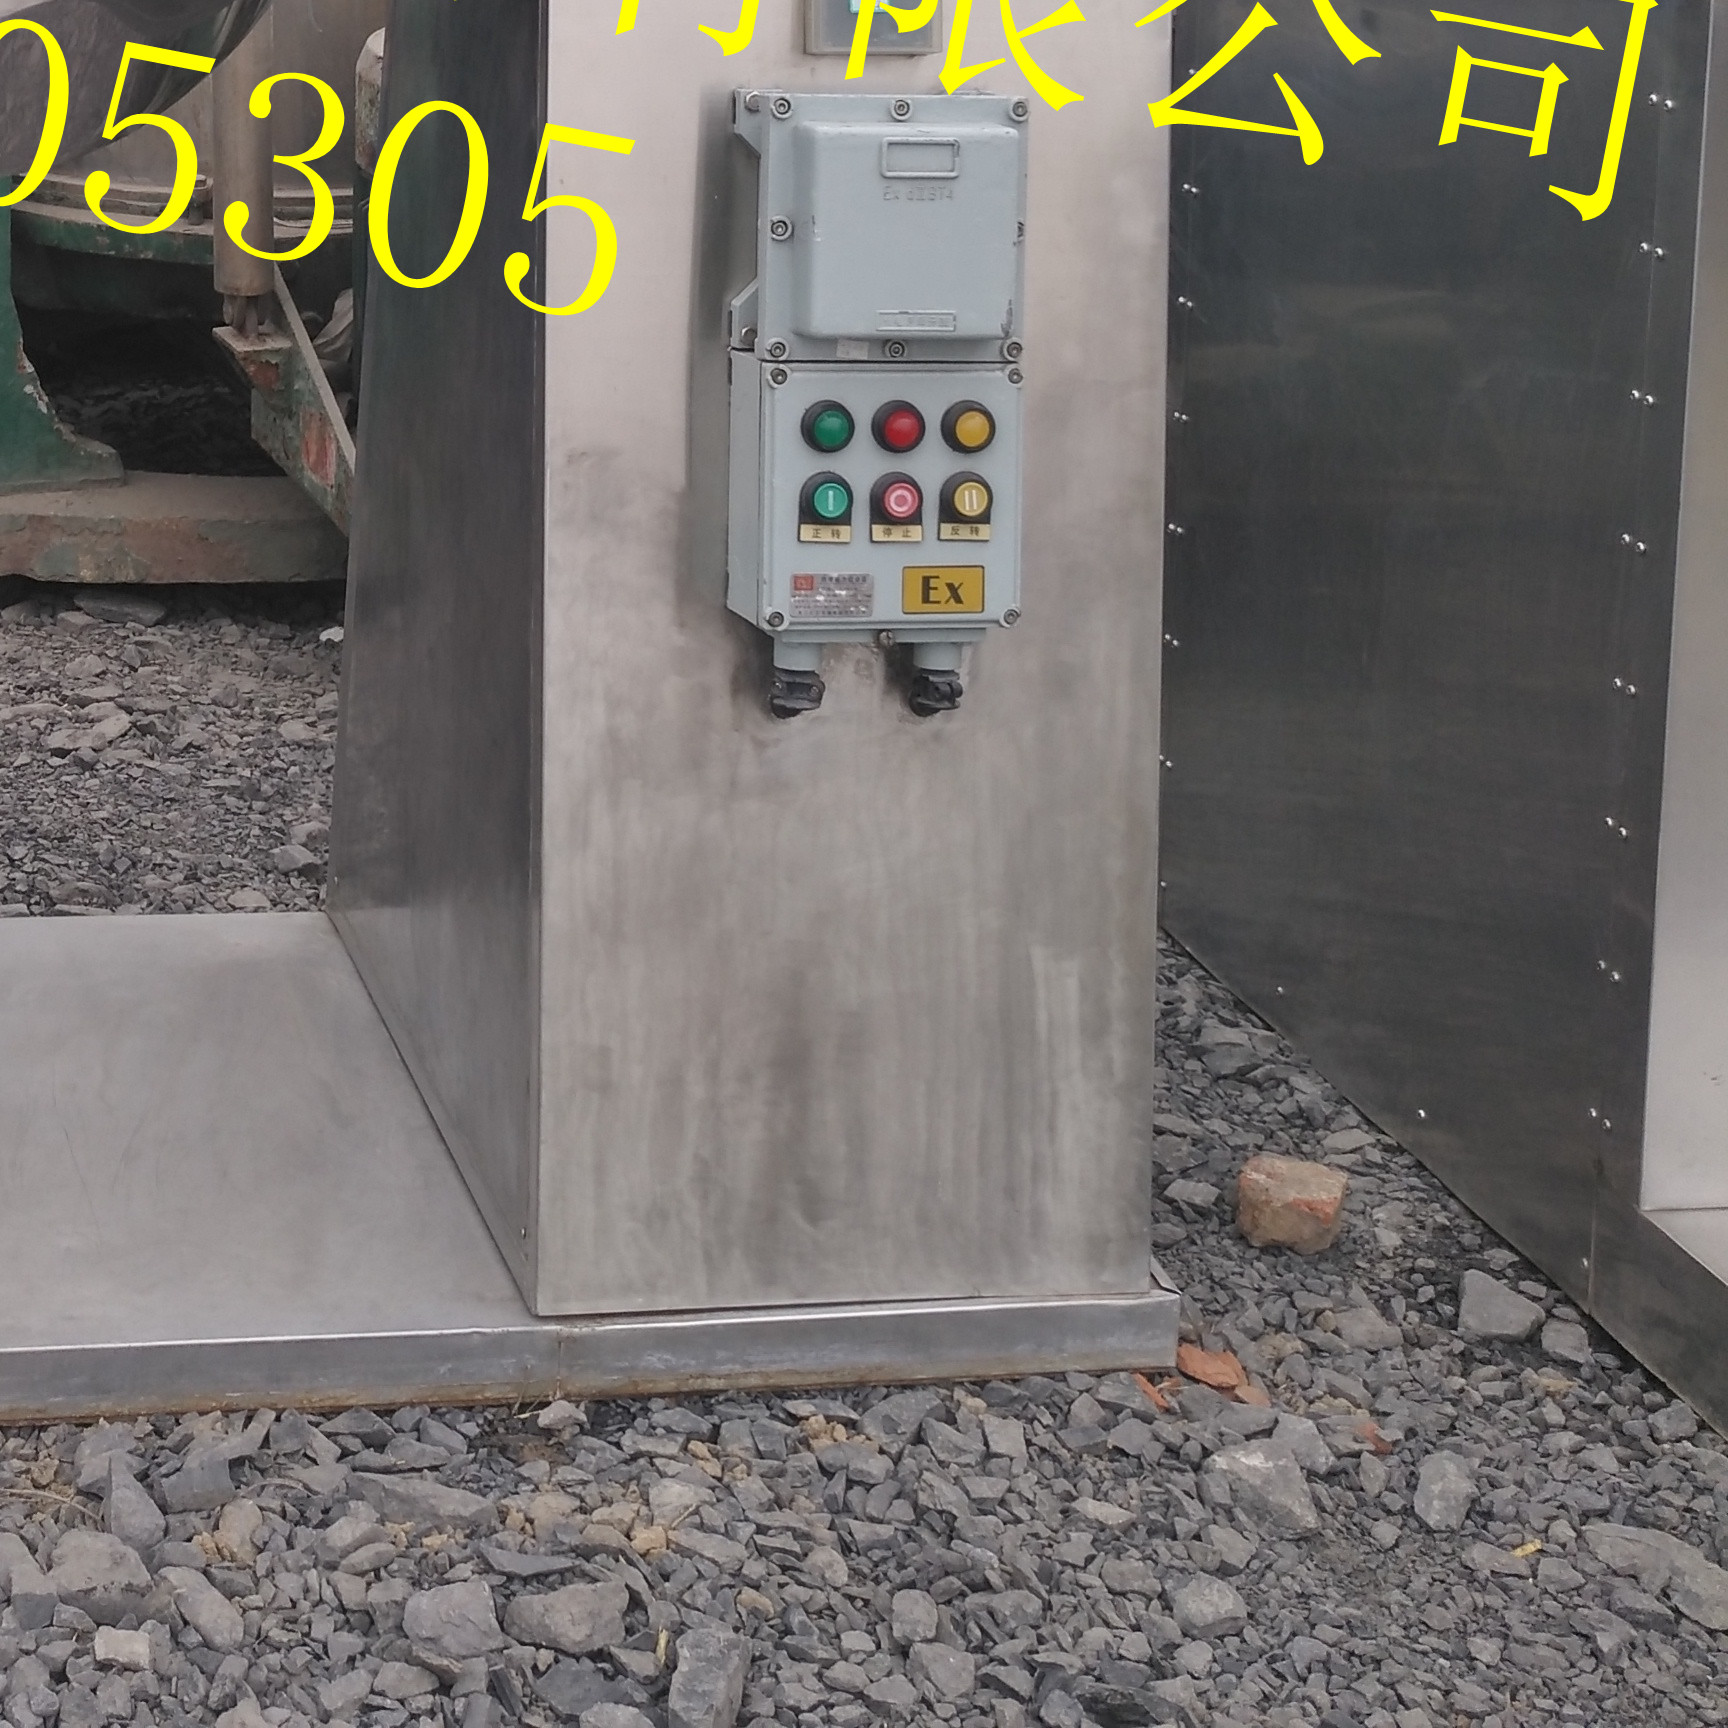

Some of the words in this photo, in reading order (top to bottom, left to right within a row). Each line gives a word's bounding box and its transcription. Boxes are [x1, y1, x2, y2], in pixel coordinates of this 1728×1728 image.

[811, 527, 842, 540] 正转
[882, 526, 912, 539] 停止
[949, 525, 980, 537] 反转
[921, 575, 964, 605] Ex
